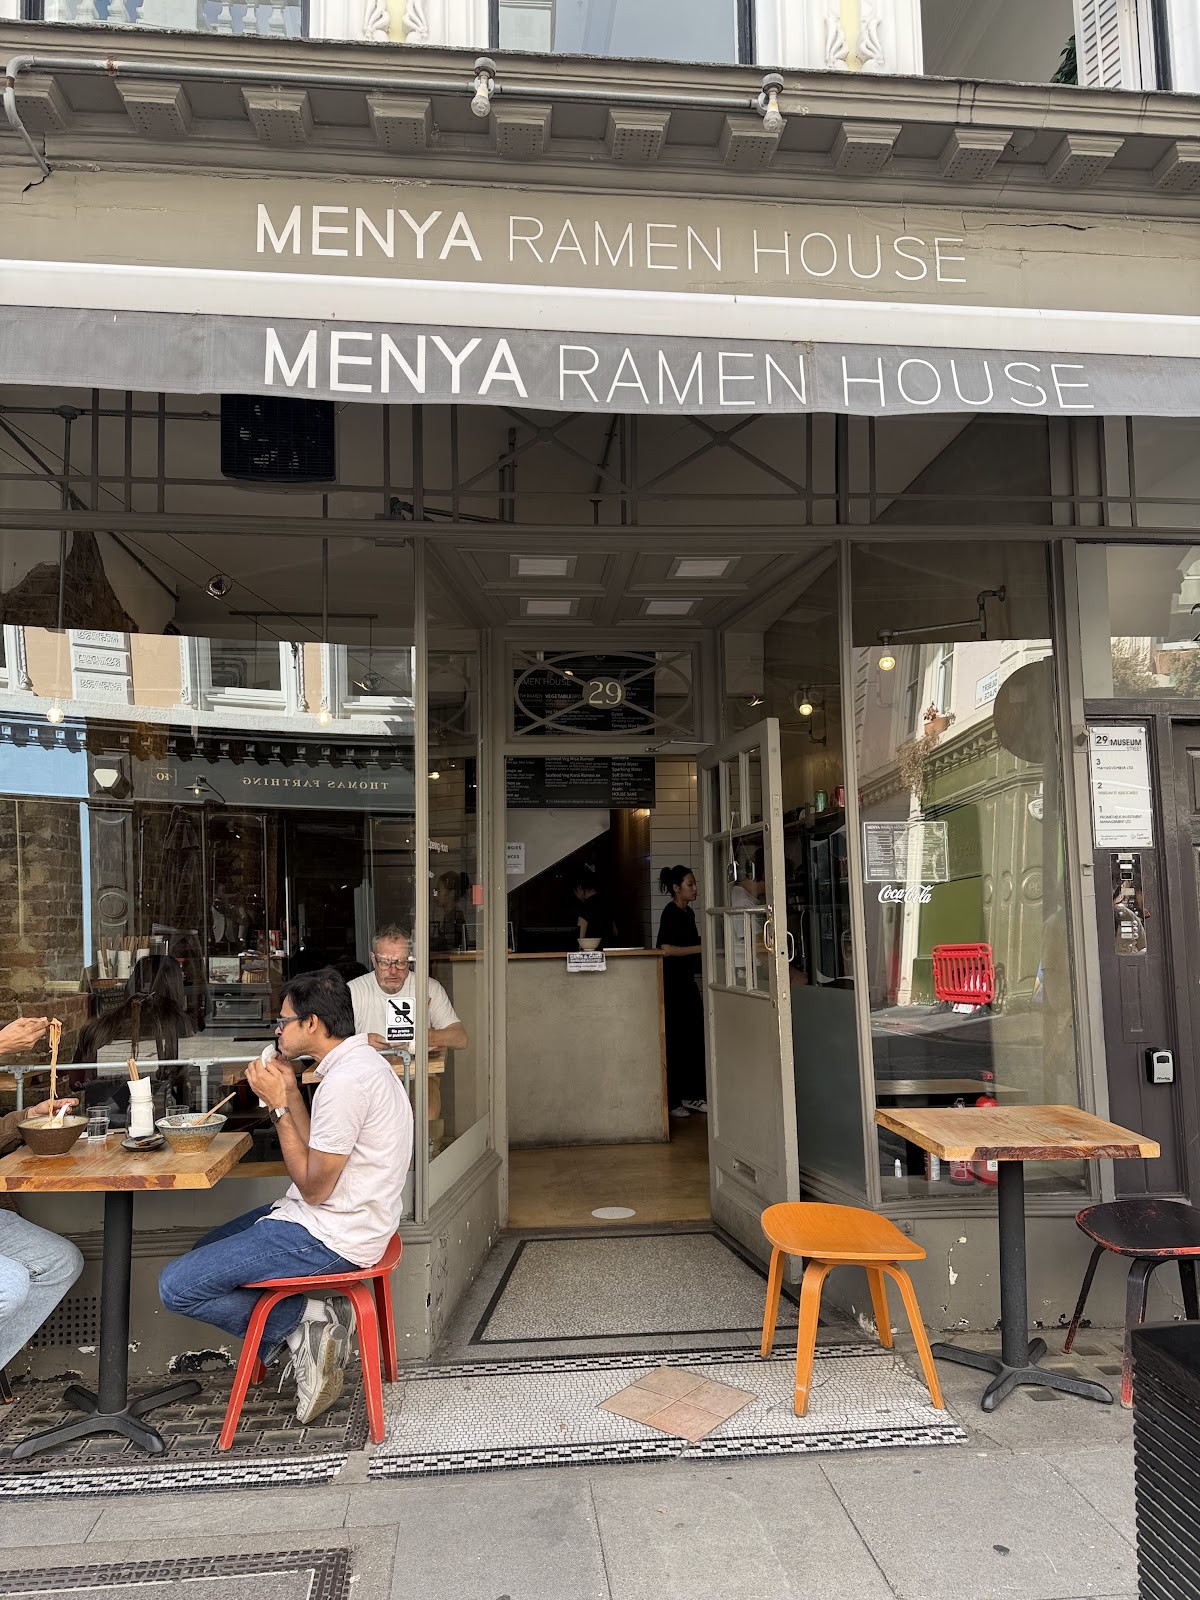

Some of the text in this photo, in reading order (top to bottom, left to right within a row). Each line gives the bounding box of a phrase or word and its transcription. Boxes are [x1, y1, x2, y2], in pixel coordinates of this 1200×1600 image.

[256, 203, 967, 284] MENYA RAMEN HOUSE
[264, 327, 1095, 409] MENYA RAMEN HOUSE
[543, 679, 571, 687] HOUSE
[589, 681, 622, 705] 29
[1096, 735, 1108, 744] 29
[246, 1443, 333, 1455] LONDON
